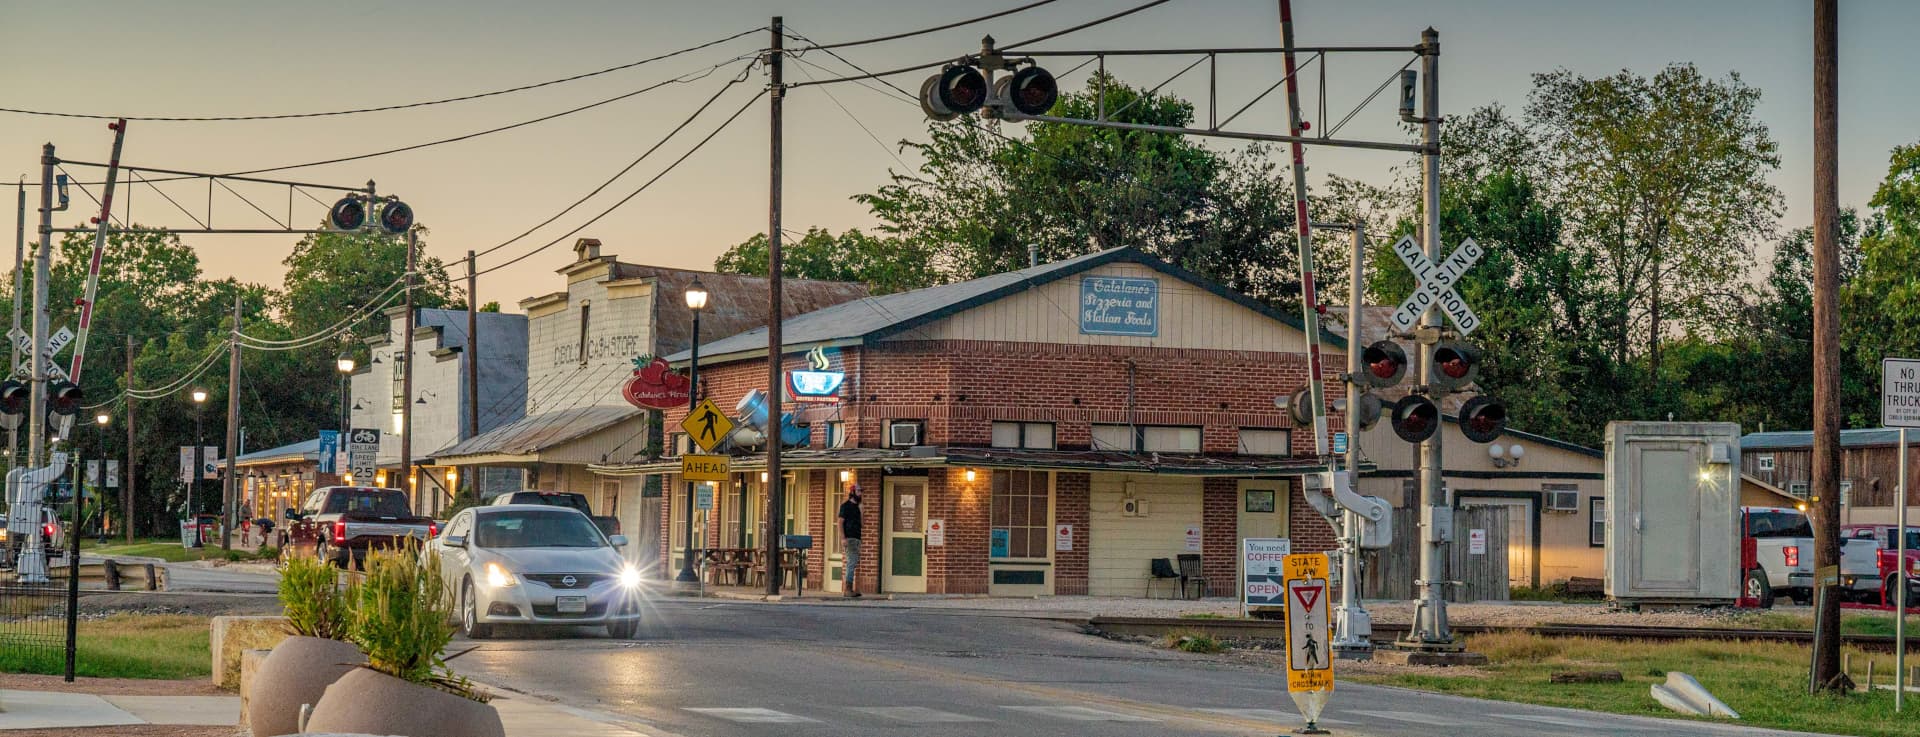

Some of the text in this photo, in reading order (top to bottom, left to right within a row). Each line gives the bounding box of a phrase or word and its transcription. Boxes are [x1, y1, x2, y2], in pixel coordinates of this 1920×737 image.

[1094, 279, 1150, 294] Catalano's
[1396, 244, 1477, 326] CROSSING
[1398, 239, 1474, 329] RAIL ROAD
[1085, 293, 1154, 311] Pizzeria and
[1085, 308, 1152, 326] Italian Foods
[611, 335, 639, 357] STORE
[1900, 368, 1915, 380] NO
[1894, 381, 1920, 394] THRU
[354, 467, 373, 478] 25
[685, 462, 727, 474] AHEAD
[1249, 543, 1286, 552] You need
[1291, 557, 1320, 567] STATE
[1296, 568, 1317, 577] LAW
[1248, 584, 1279, 594] OPEN
[1305, 622, 1314, 630] TO
[1292, 679, 1330, 689] CROSSWALK
